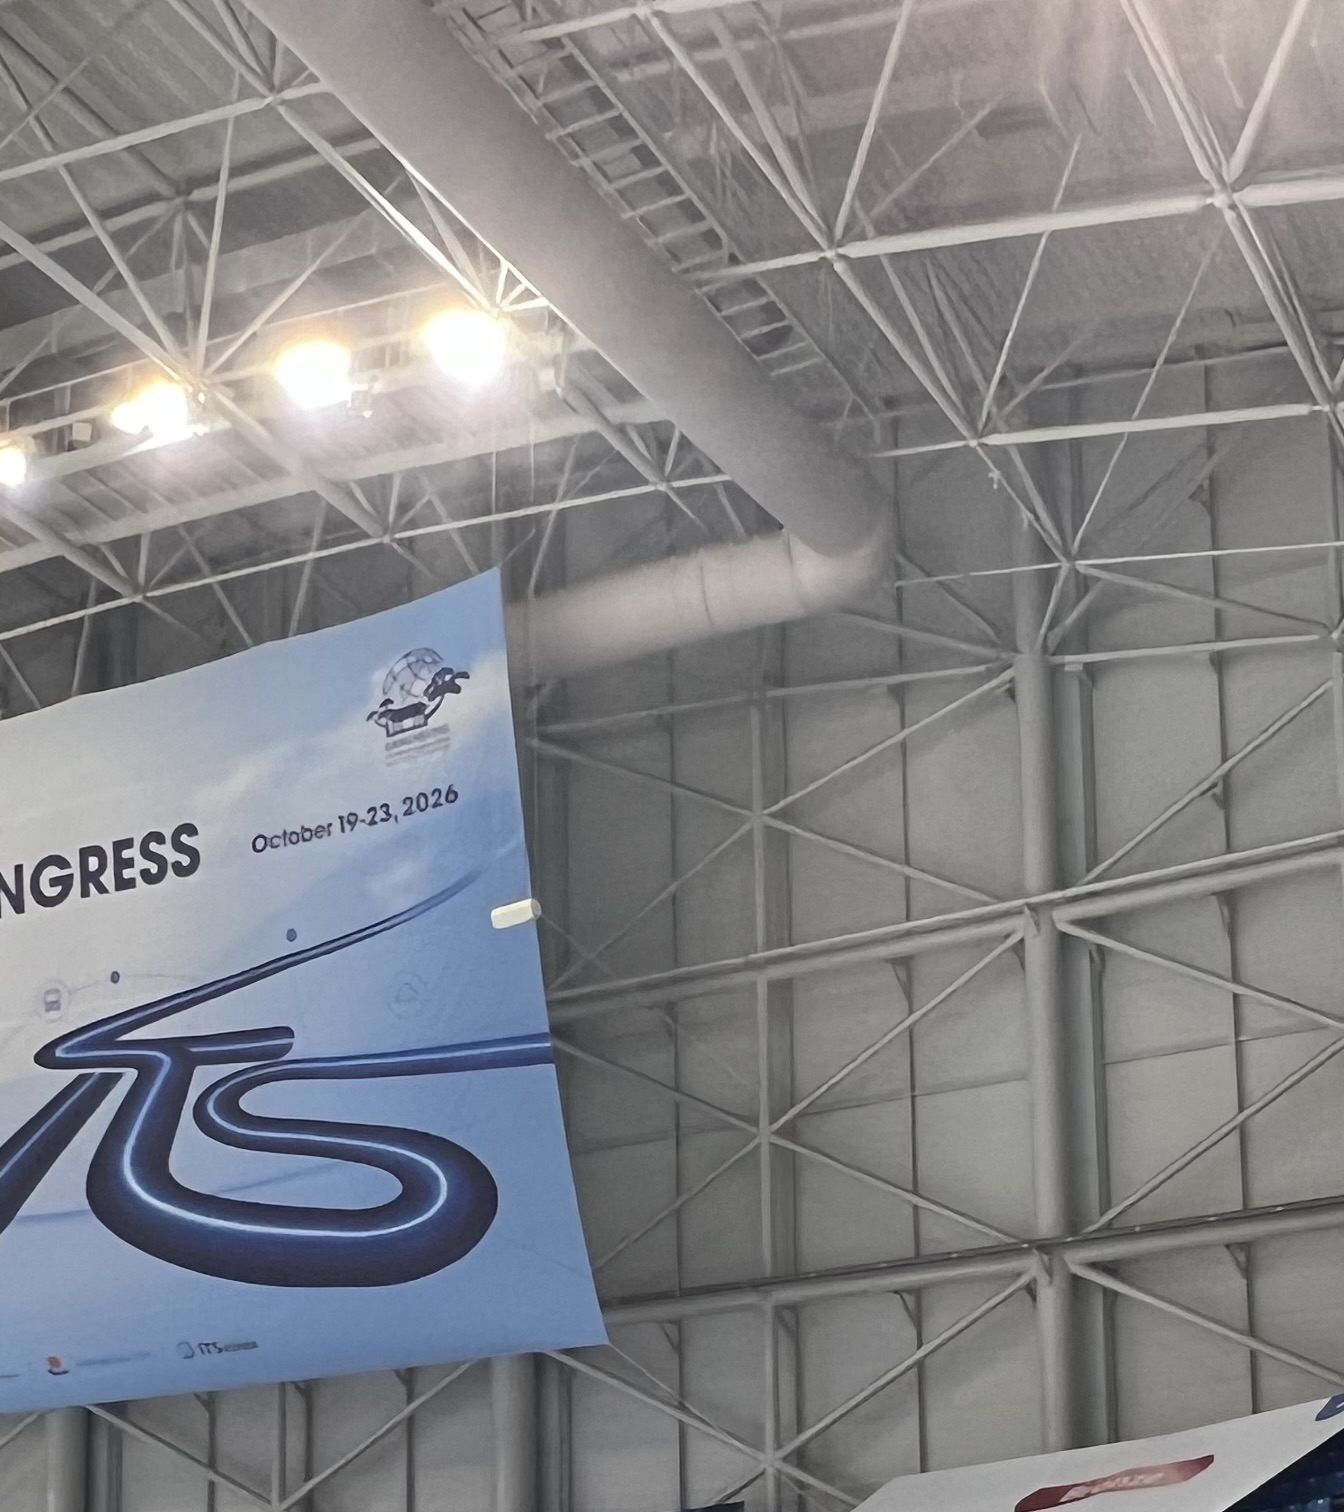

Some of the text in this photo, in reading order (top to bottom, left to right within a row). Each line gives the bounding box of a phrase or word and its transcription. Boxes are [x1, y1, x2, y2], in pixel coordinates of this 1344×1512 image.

[251, 783, 459, 854] October 19-23, 2026
